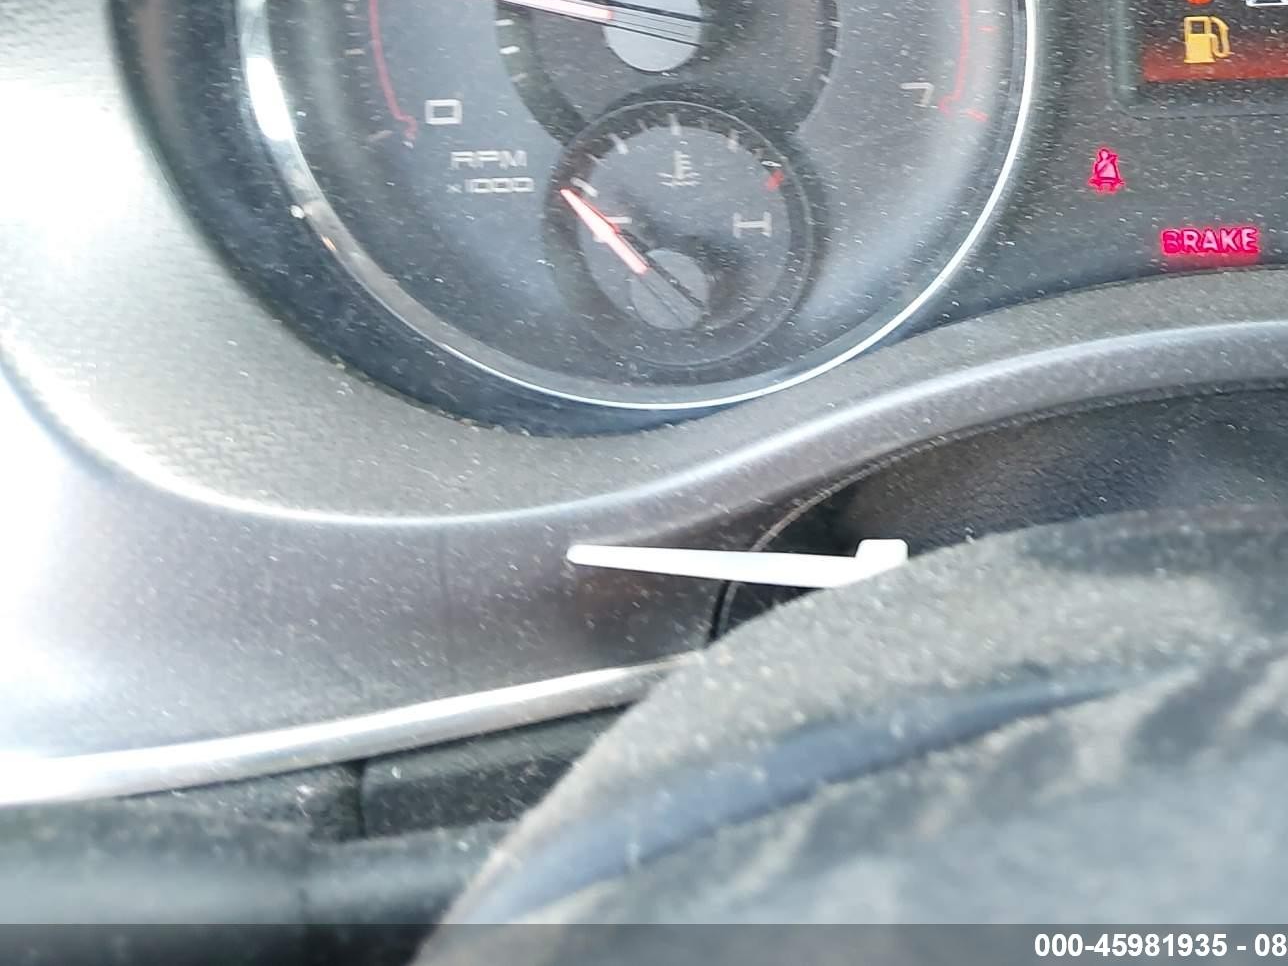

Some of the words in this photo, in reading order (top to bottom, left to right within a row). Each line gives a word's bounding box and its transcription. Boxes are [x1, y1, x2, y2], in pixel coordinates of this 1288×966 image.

[900, 82, 934, 106] 7
[425, 99, 462, 124] 0
[450, 150, 527, 169] RPM
[732, 211, 773, 238] H
[1161, 227, 1258, 254] BRAKE
